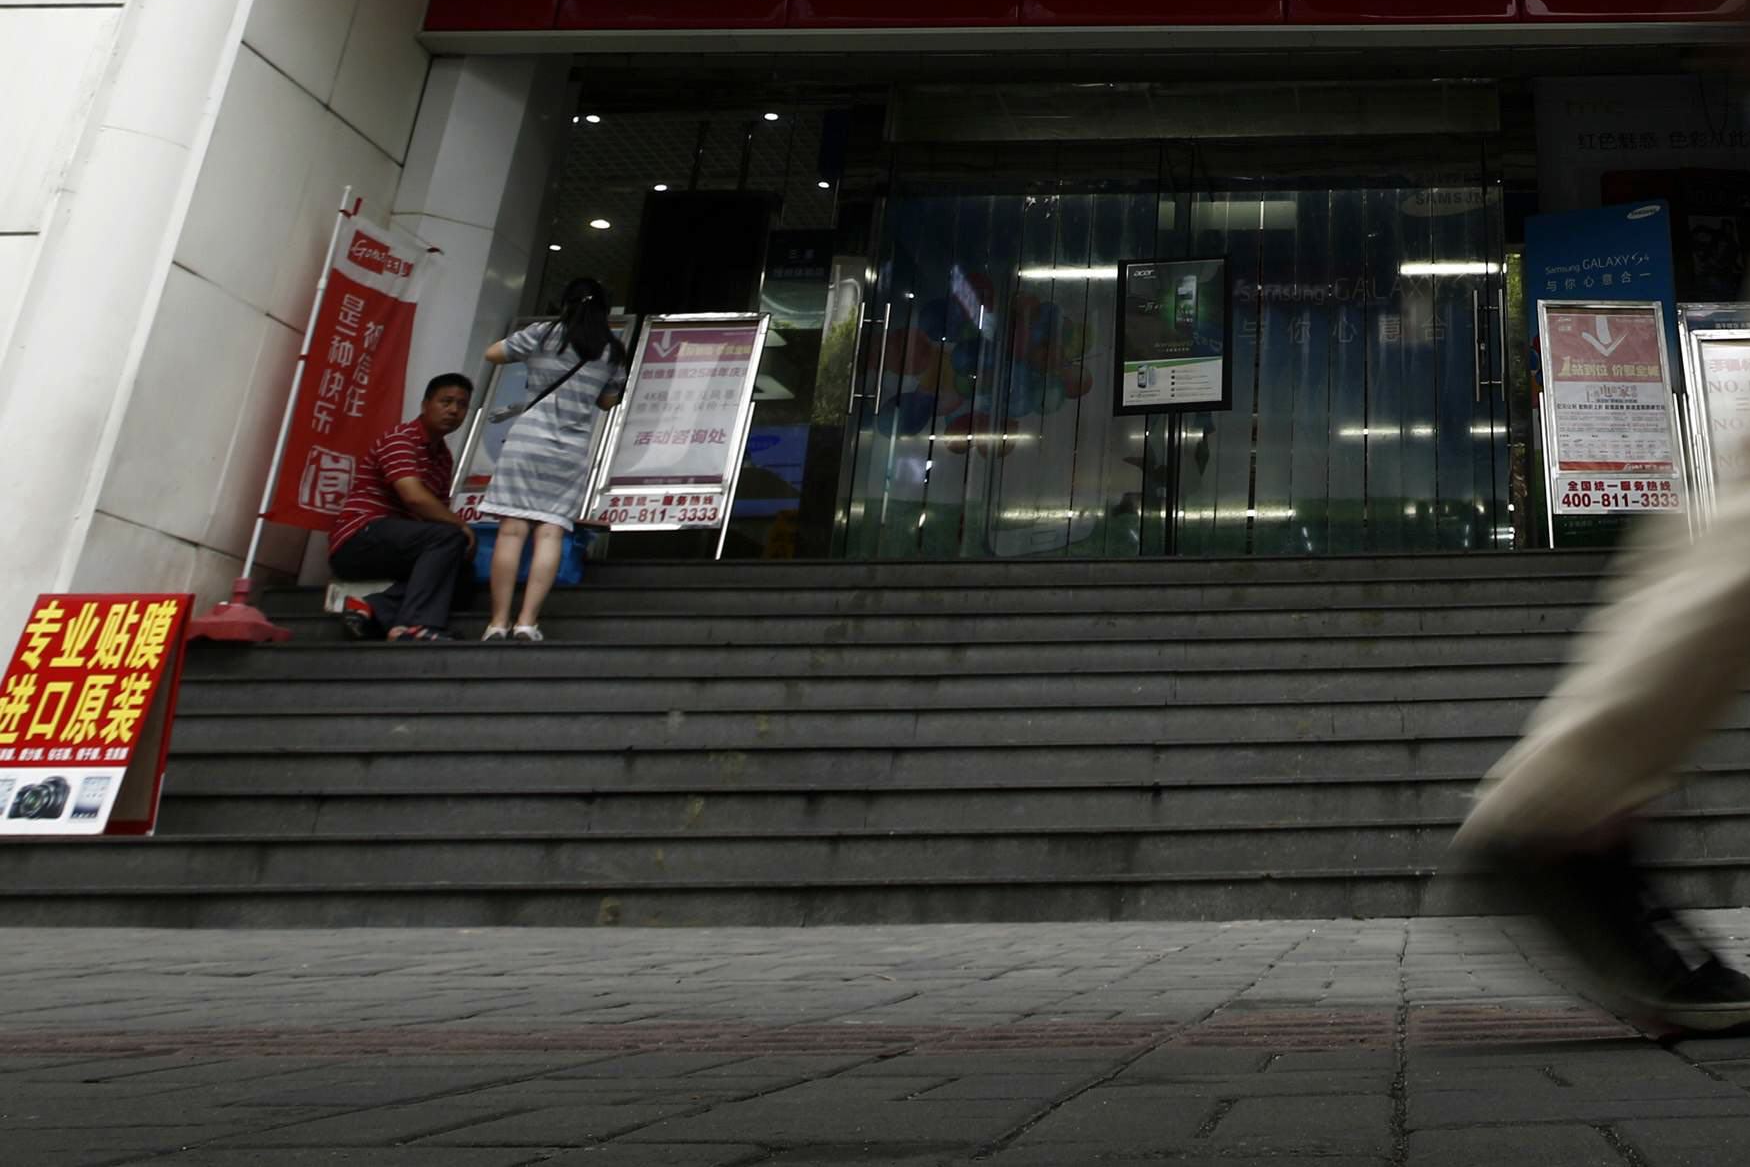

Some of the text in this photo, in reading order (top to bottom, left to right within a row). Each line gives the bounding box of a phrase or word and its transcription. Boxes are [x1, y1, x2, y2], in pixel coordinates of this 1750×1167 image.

[1582, 255, 1630, 271] GALAXY
[310, 293, 365, 436] 是一种快乐
[1567, 480, 1672, 492] 全国统一服务热线
[1561, 493, 1680, 508] 400-811-3333
[597, 507, 719, 523] 400-811-3333
[20, 599, 179, 671] 专业贴膜
[0, 672, 152, 745] 进口原装
